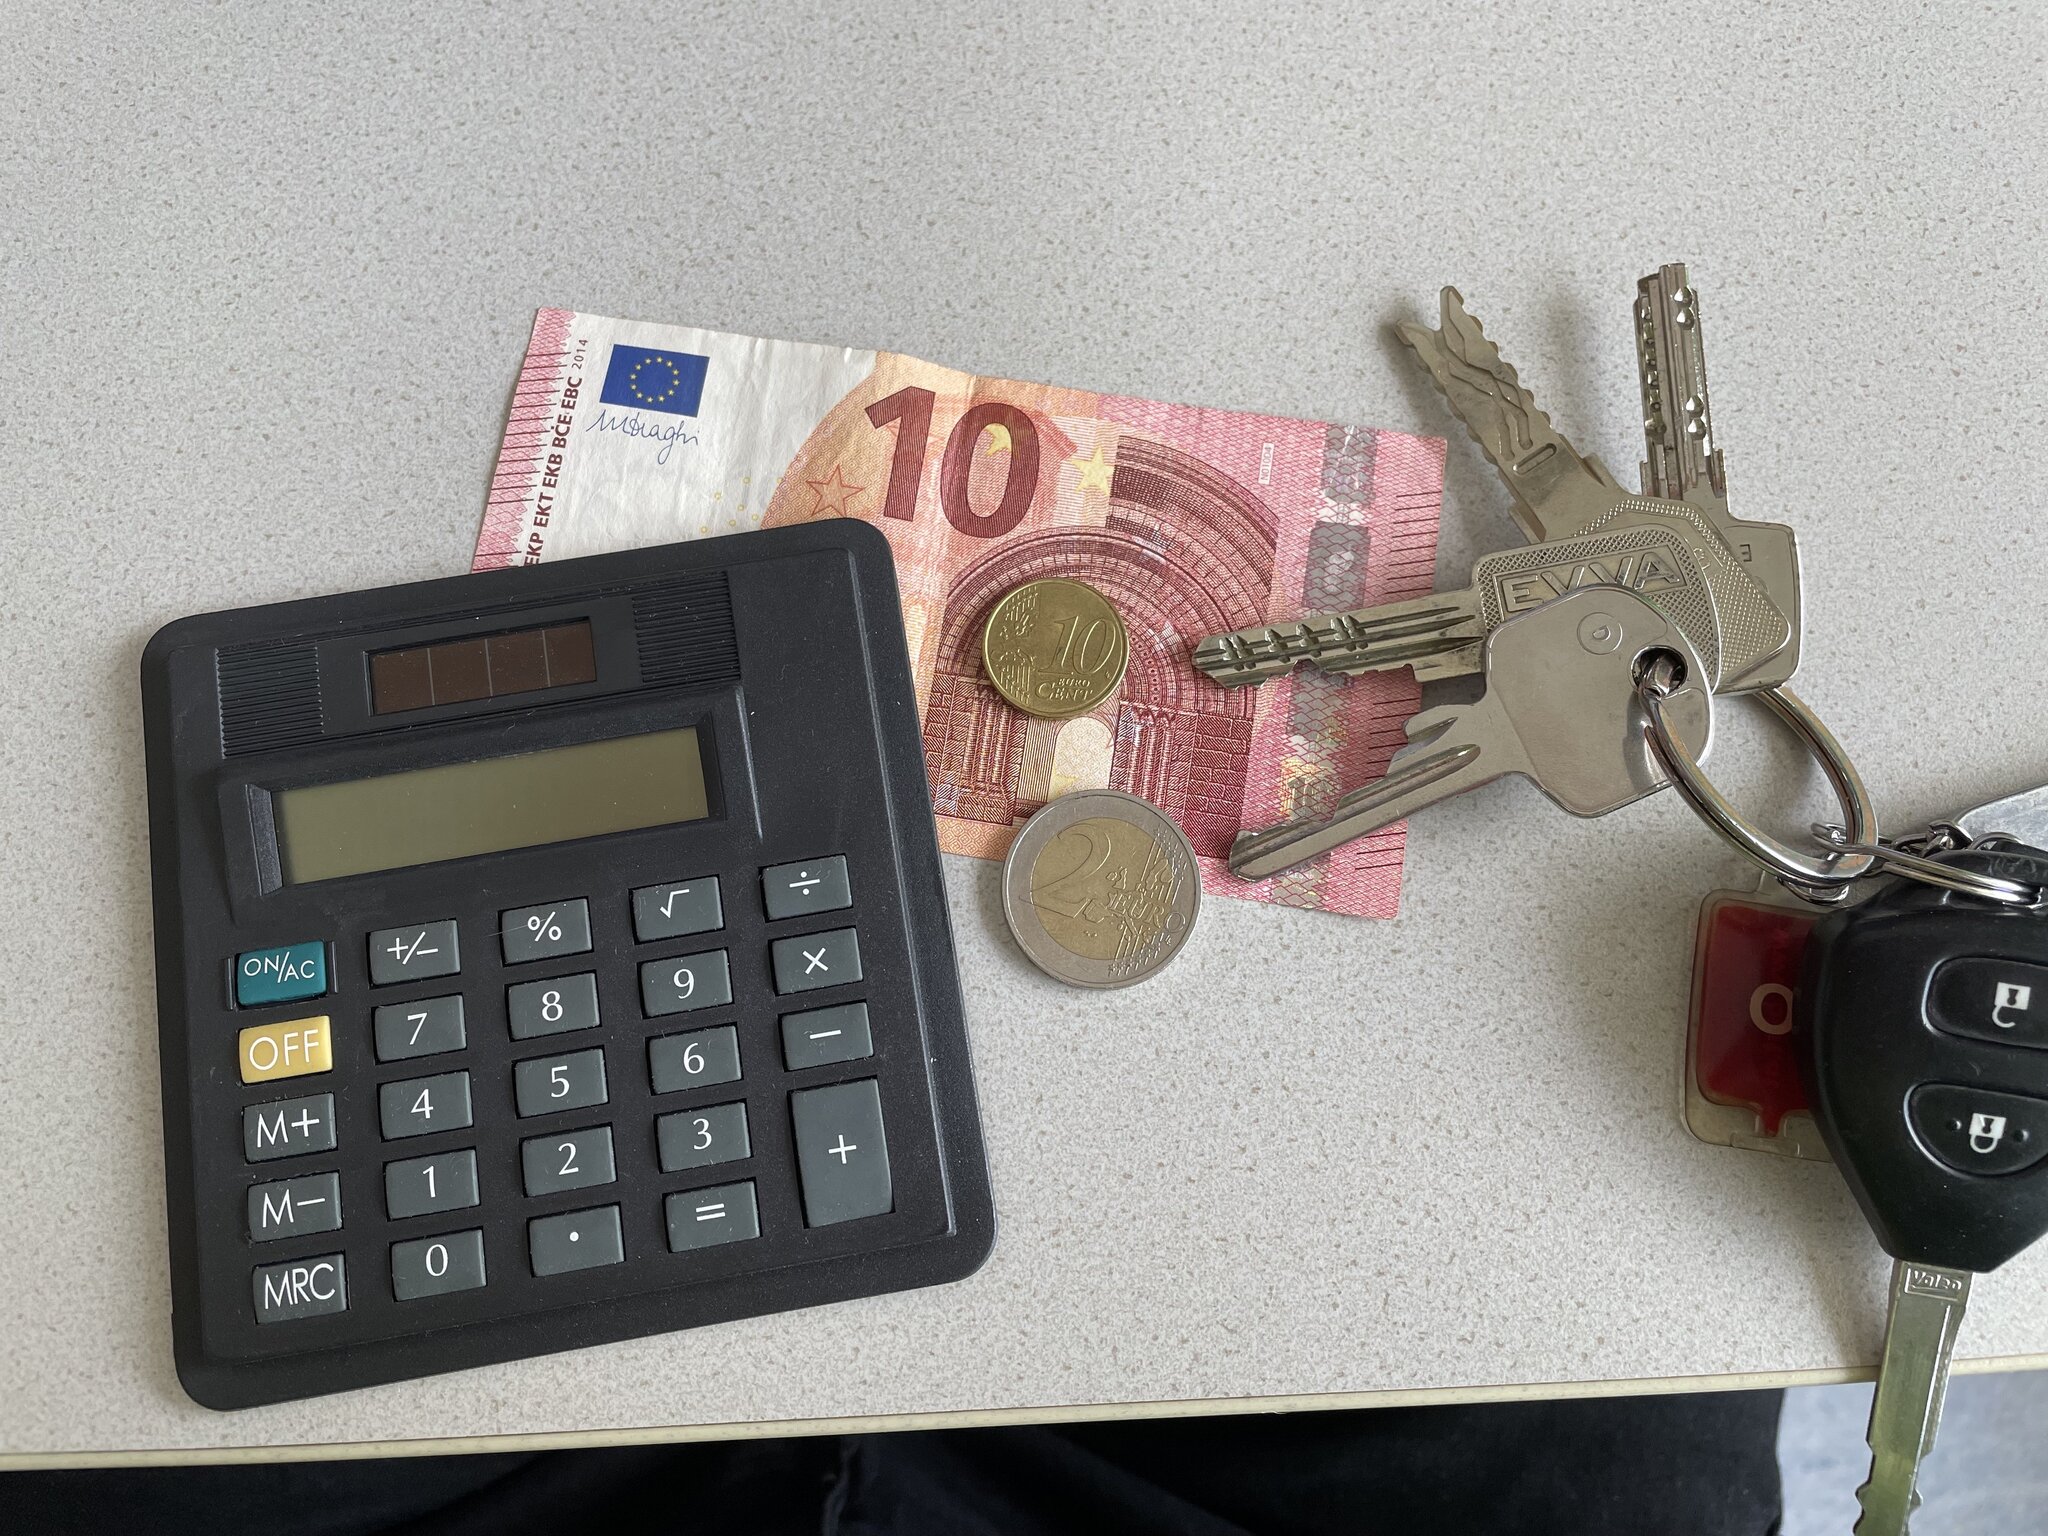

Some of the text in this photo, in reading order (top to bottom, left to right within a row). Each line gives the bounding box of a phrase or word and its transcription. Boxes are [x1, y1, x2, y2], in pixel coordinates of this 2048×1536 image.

[571, 340, 588, 370] 2014
[561, 376, 582, 410] EBC
[542, 454, 563, 488] EKB
[865, 386, 1040, 538] 10
[1037, 615, 1116, 676] 10
[528, 912, 561, 941] %
[245, 952, 314, 983] ON/AC
[674, 969, 694, 999] 9
[542, 991, 563, 1021] 8
[408, 1013, 427, 1045] 7
[250, 1029, 318, 1070] OFF
[684, 1043, 704, 1074] 6
[551, 1066, 569, 1097] 5
[411, 1089, 433, 1118] 4
[257, 1109, 319, 1147] M+
[693, 1119, 712, 1149] 3
[558, 1143, 579, 1175] 2
[423, 1166, 435, 1197] 1
[426, 1244, 448, 1276] 0
[265, 1263, 335, 1309] MRC
